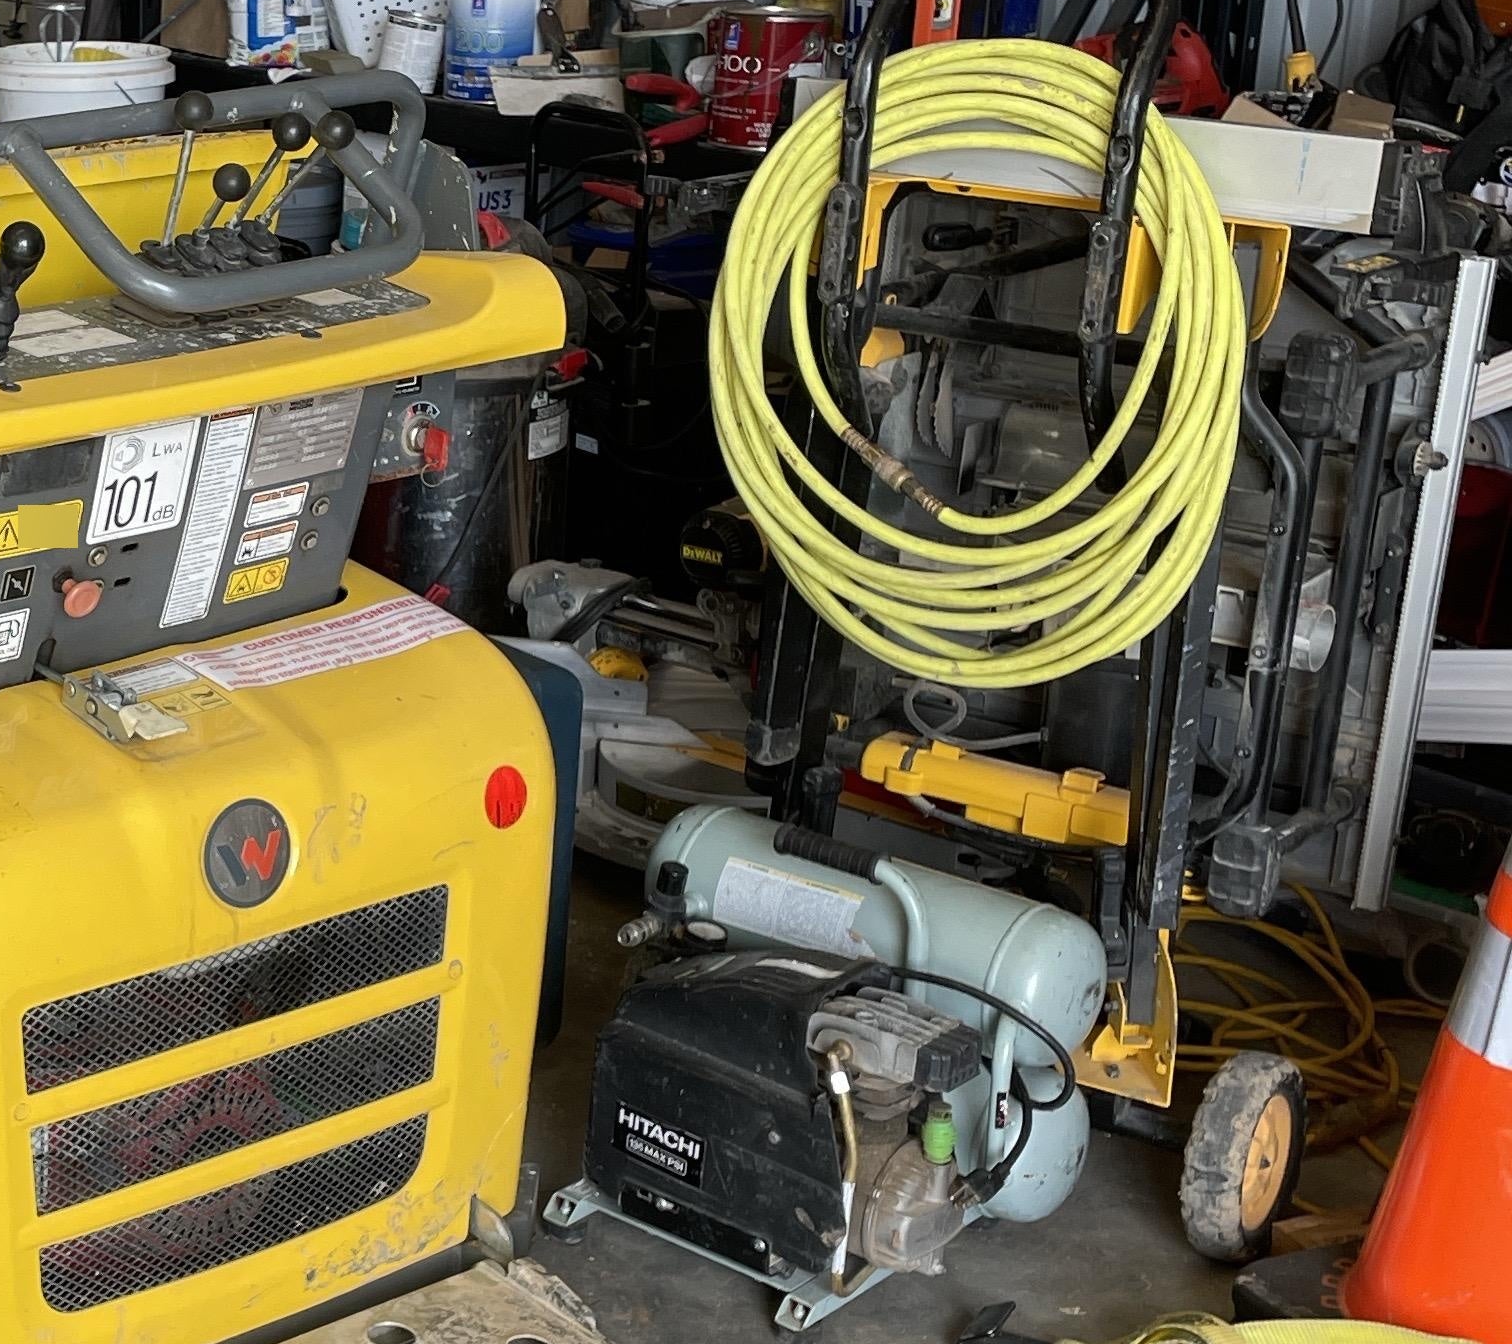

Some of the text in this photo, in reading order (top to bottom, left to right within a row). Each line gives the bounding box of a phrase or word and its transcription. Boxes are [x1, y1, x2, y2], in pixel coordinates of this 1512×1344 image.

[455, 30, 504, 53] 200
[104, 470, 159, 531] 101
[618, 1108, 700, 1159] HITACHI
